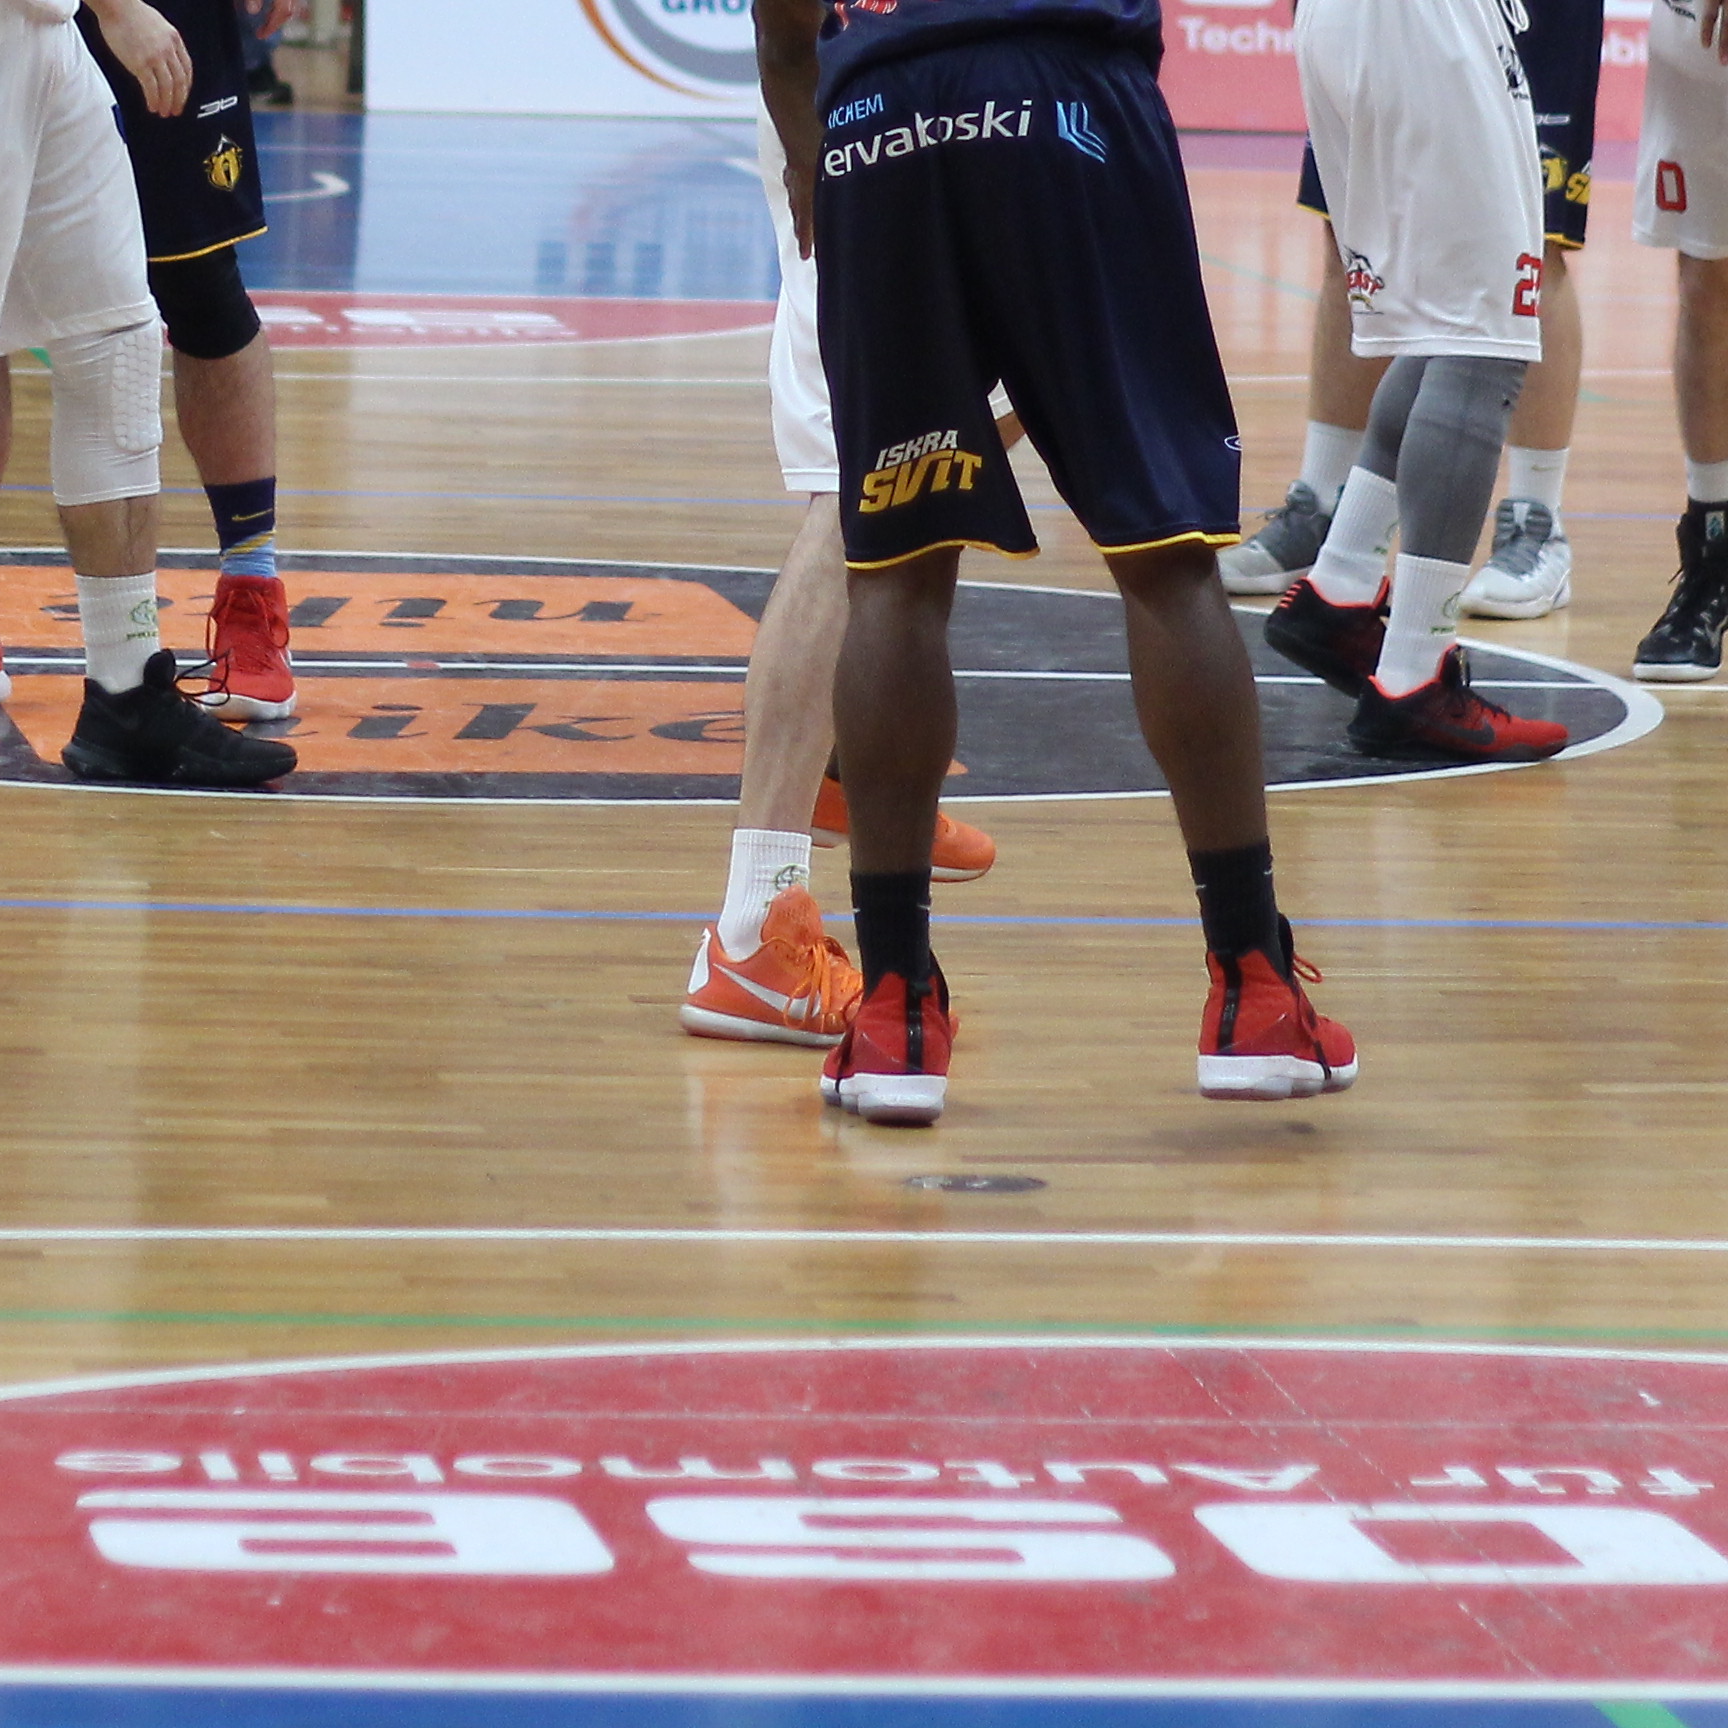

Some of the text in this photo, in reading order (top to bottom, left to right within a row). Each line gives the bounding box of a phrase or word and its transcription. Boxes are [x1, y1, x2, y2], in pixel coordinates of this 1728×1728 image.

[822, 98, 1034, 183] ervakoski
[857, 448, 984, 515] SVIT
[874, 428, 960, 472] ISKRA
